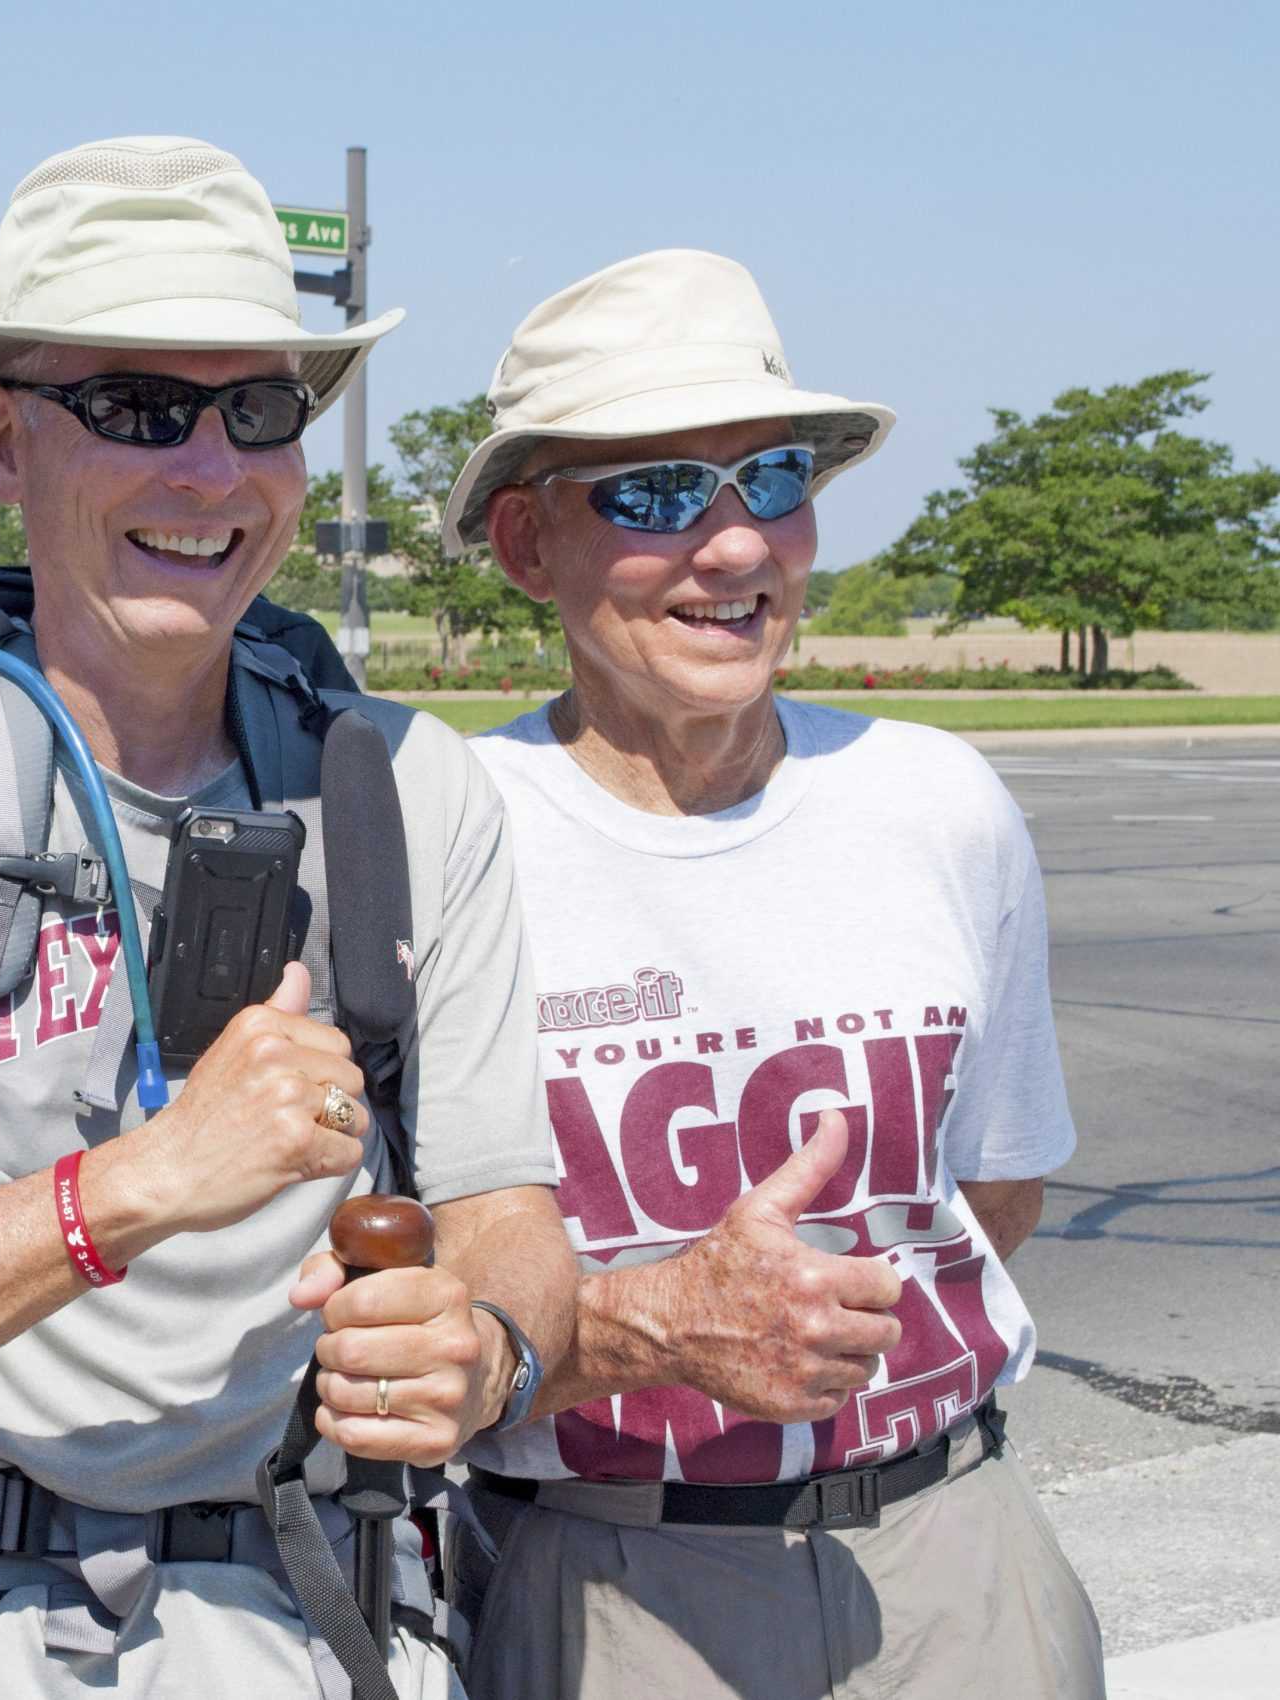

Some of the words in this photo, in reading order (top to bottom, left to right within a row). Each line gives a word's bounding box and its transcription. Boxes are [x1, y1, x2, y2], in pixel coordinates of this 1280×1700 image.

[306, 221, 341, 243] Ave
[556, 1027, 757, 1069] YOU'RE
[794, 1009, 894, 1042] NOT
[923, 1006, 967, 1027] AN
